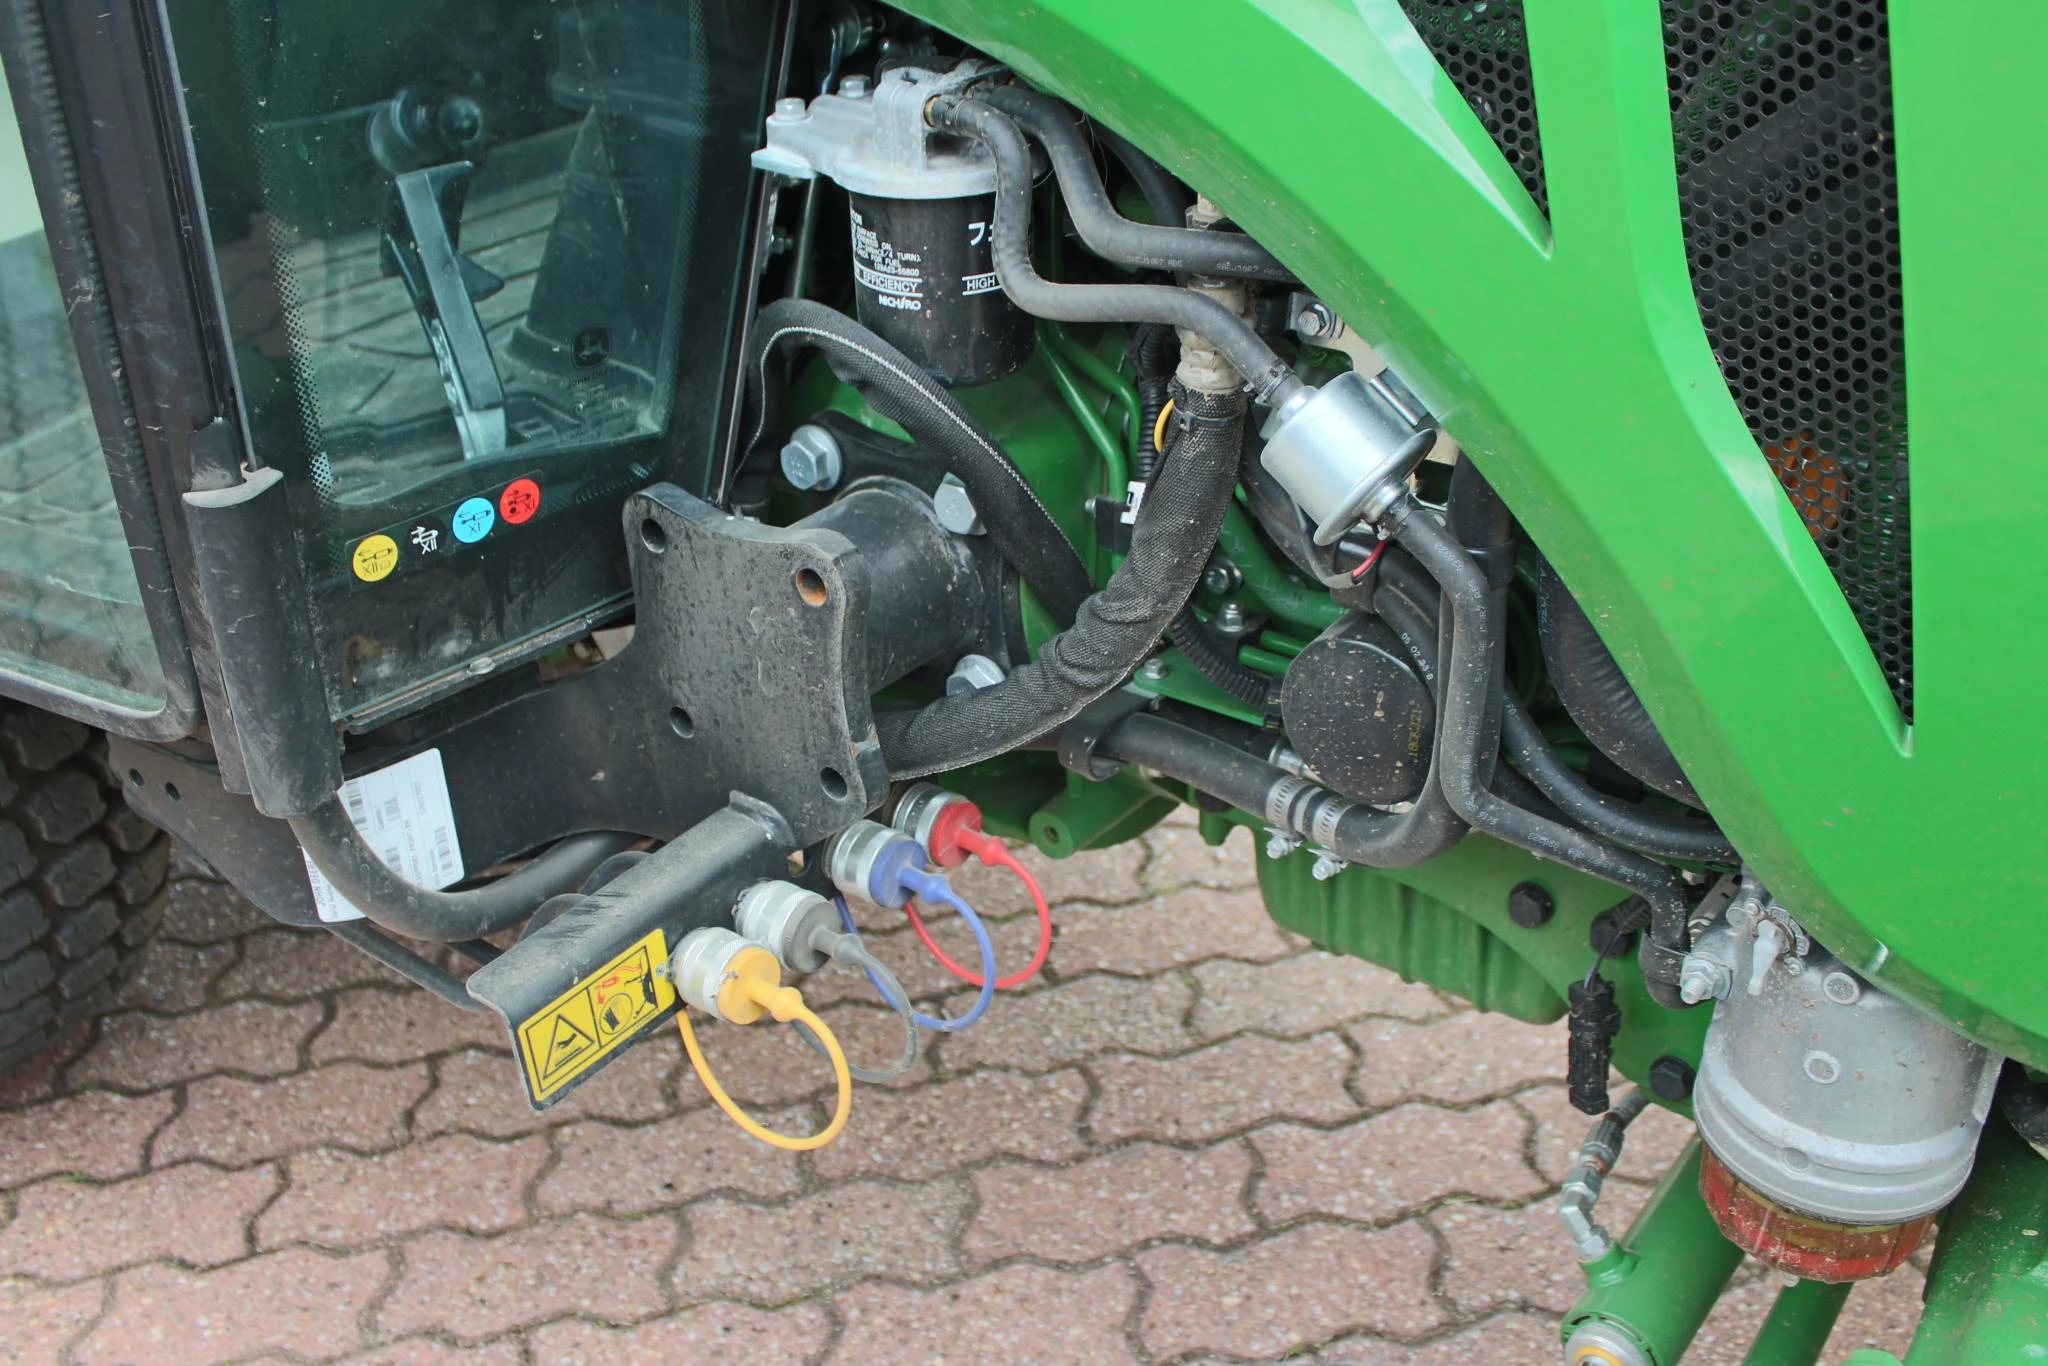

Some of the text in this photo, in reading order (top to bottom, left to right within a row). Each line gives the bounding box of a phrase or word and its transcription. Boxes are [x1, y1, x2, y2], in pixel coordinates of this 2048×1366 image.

[863, 271, 918, 293] EFFICIENCY
[966, 275, 996, 291] HIGH
[420, 538, 438, 555] XII
[1401, 632, 1410, 644] 05
[1410, 645, 1421, 659] 02
